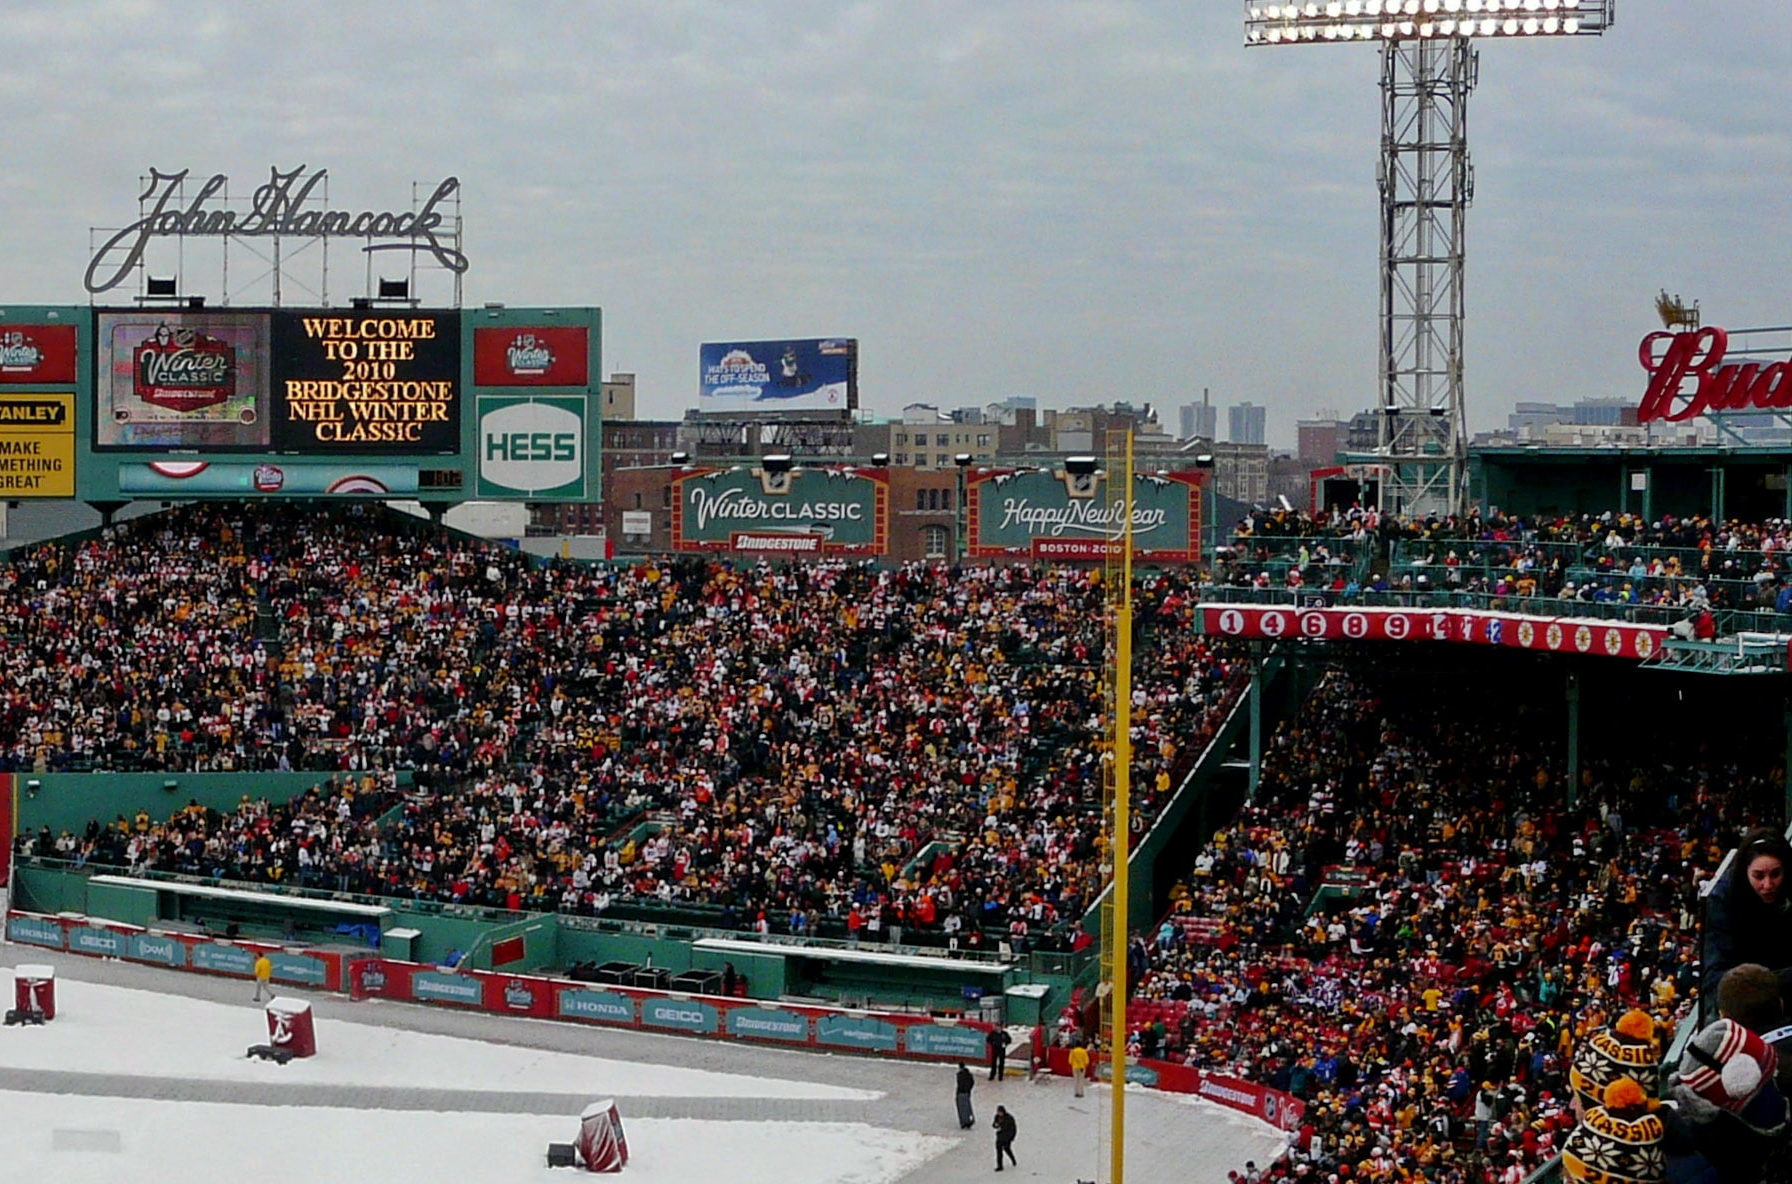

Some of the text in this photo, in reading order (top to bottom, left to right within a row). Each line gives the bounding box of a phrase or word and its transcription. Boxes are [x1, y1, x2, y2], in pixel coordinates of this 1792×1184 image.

[84, 164, 469, 292] John Hancock
[302, 318, 436, 339] WELCOME
[322, 340, 415, 361] TO THE
[141, 348, 228, 385] Winter
[157, 370, 224, 383] CLASSIC
[341, 361, 397, 381] 2010
[704, 371, 771, 385] THE OFF-SEASON
[284, 380, 454, 401] BRIDGESTONE
[288, 401, 450, 422] NHL WINTER
[315, 422, 423, 442] CLASSIC
[486, 432, 576, 462] HESS
[690, 487, 862, 531] Winter CLASSIC
[736, 534, 819, 550] BRIDGESTONE
[1263, 611, 1280, 633] 4
[1304, 614, 1323, 634] 6
[1345, 614, 1366, 635] 8
[1387, 616, 1407, 637] 9
[576, 1002, 628, 1016] HONDA
[654, 1008, 703, 1024] GEICO
[736, 1015, 803, 1034] BRIDGESTONE
